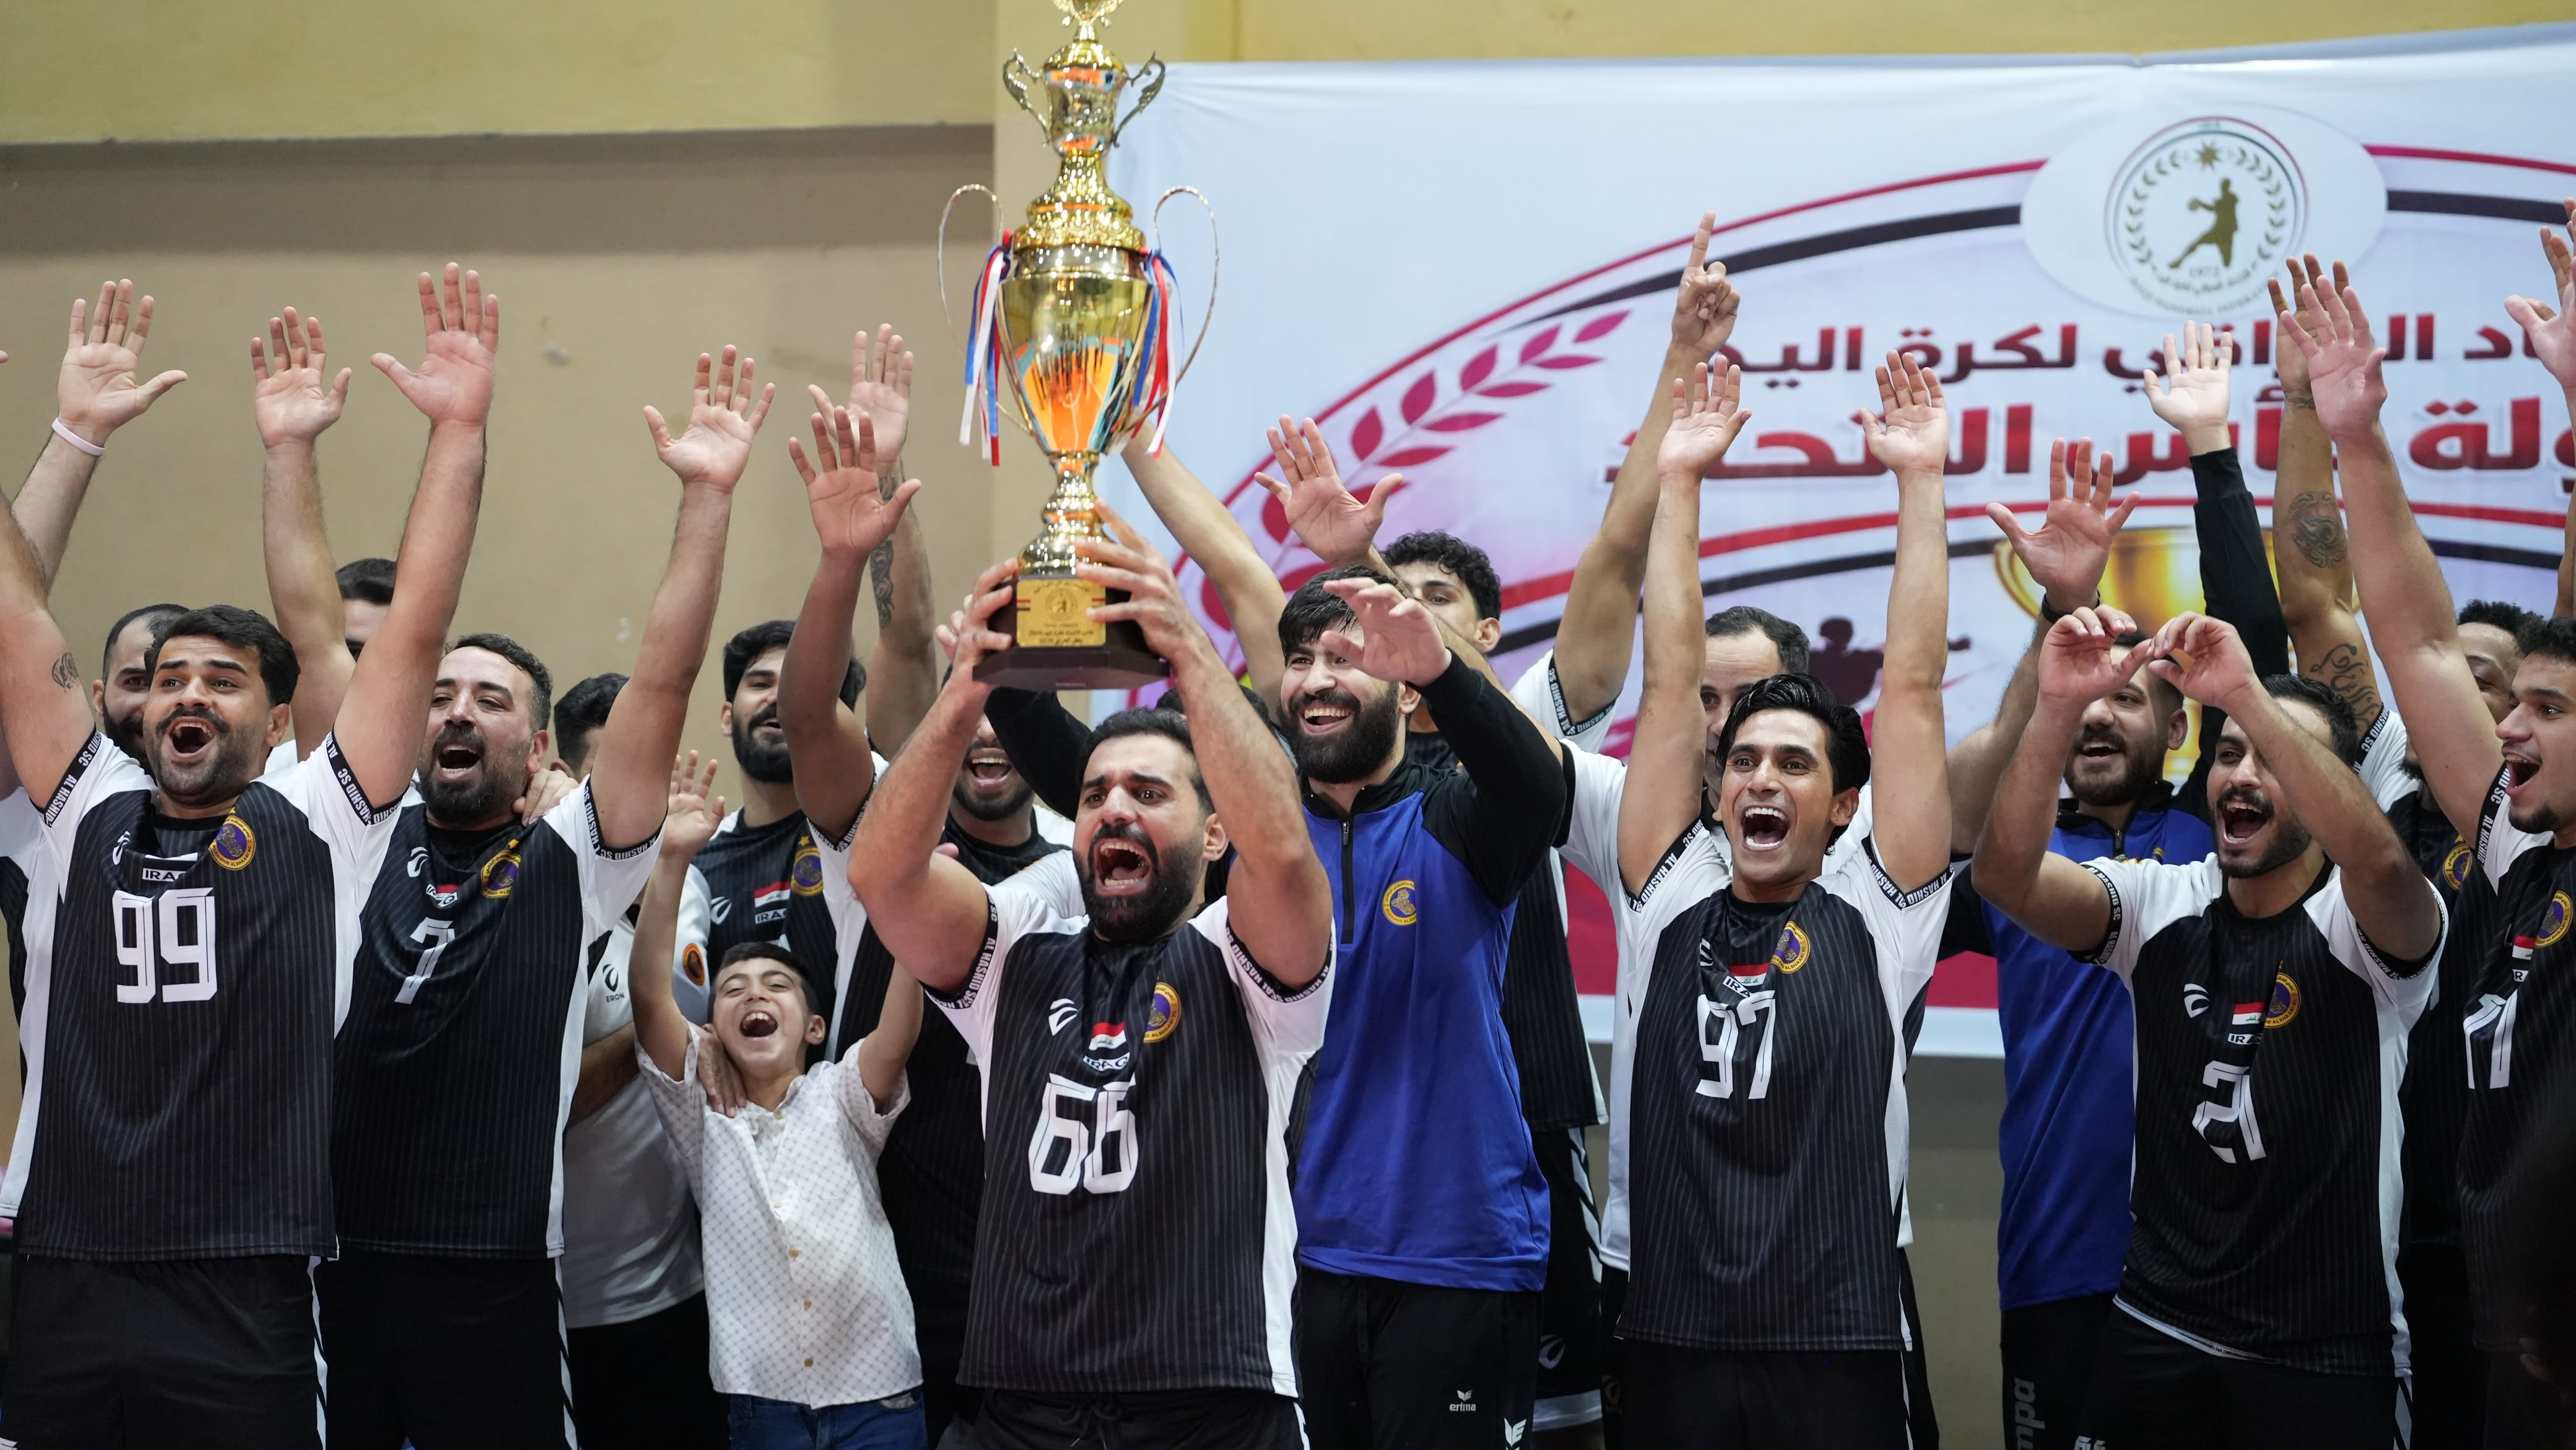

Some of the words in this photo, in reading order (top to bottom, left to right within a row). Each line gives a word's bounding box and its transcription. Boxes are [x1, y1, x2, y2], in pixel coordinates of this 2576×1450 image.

[1551, 683, 1566, 719] HASHID
[2361, 737, 2373, 752] SC
[78, 750, 92, 766] SC
[64, 774, 77, 788] AL
[337, 768, 352, 785] SC
[2491, 787, 2506, 804] SC
[585, 802, 599, 844] HASHID
[2483, 815, 2493, 827] AL
[1683, 832, 1694, 846] SC
[614, 843, 648, 860] HASHID
[1665, 853, 1677, 865] AL
[146, 870, 183, 880] IRA
[1642, 865, 1669, 903] HASHID
[1907, 880, 1939, 905] HASHID
[990, 905, 997, 922] SC
[2113, 908, 2120, 921] SC
[112, 888, 218, 1004] 99
[985, 937, 996, 950] AL
[394, 919, 456, 1005] 7
[1232, 945, 1262, 983] HASHID
[1785, 952, 1804, 970] ALSHAABI
[968, 953, 991, 991] HASHID
[606, 992, 625, 1003] ERON
[1284, 979, 1321, 1002] HASHID
[1695, 989, 1776, 1100] 97
[1028, 1073, 1139, 1195] 66
[1449, 1402, 1476, 1412] erima
